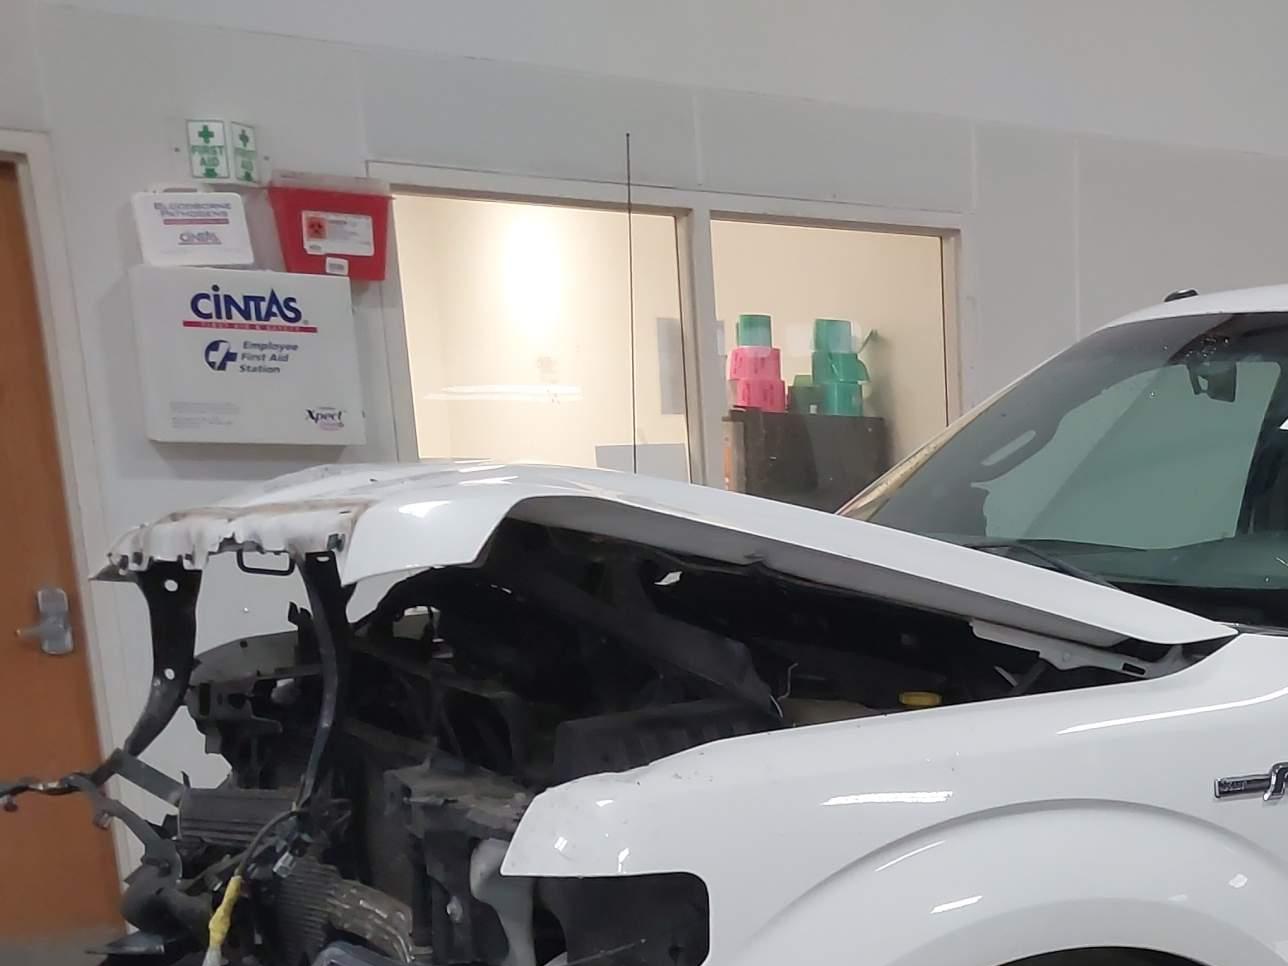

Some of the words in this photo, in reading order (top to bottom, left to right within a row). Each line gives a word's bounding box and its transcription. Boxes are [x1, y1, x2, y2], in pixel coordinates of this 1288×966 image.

[199, 156, 220, 168] AID
[190, 284, 303, 324] CINTAS
[242, 341, 299, 353] Employee
[240, 352, 266, 362] First
[269, 353, 289, 363] Aid
[239, 364, 281, 374] Station
